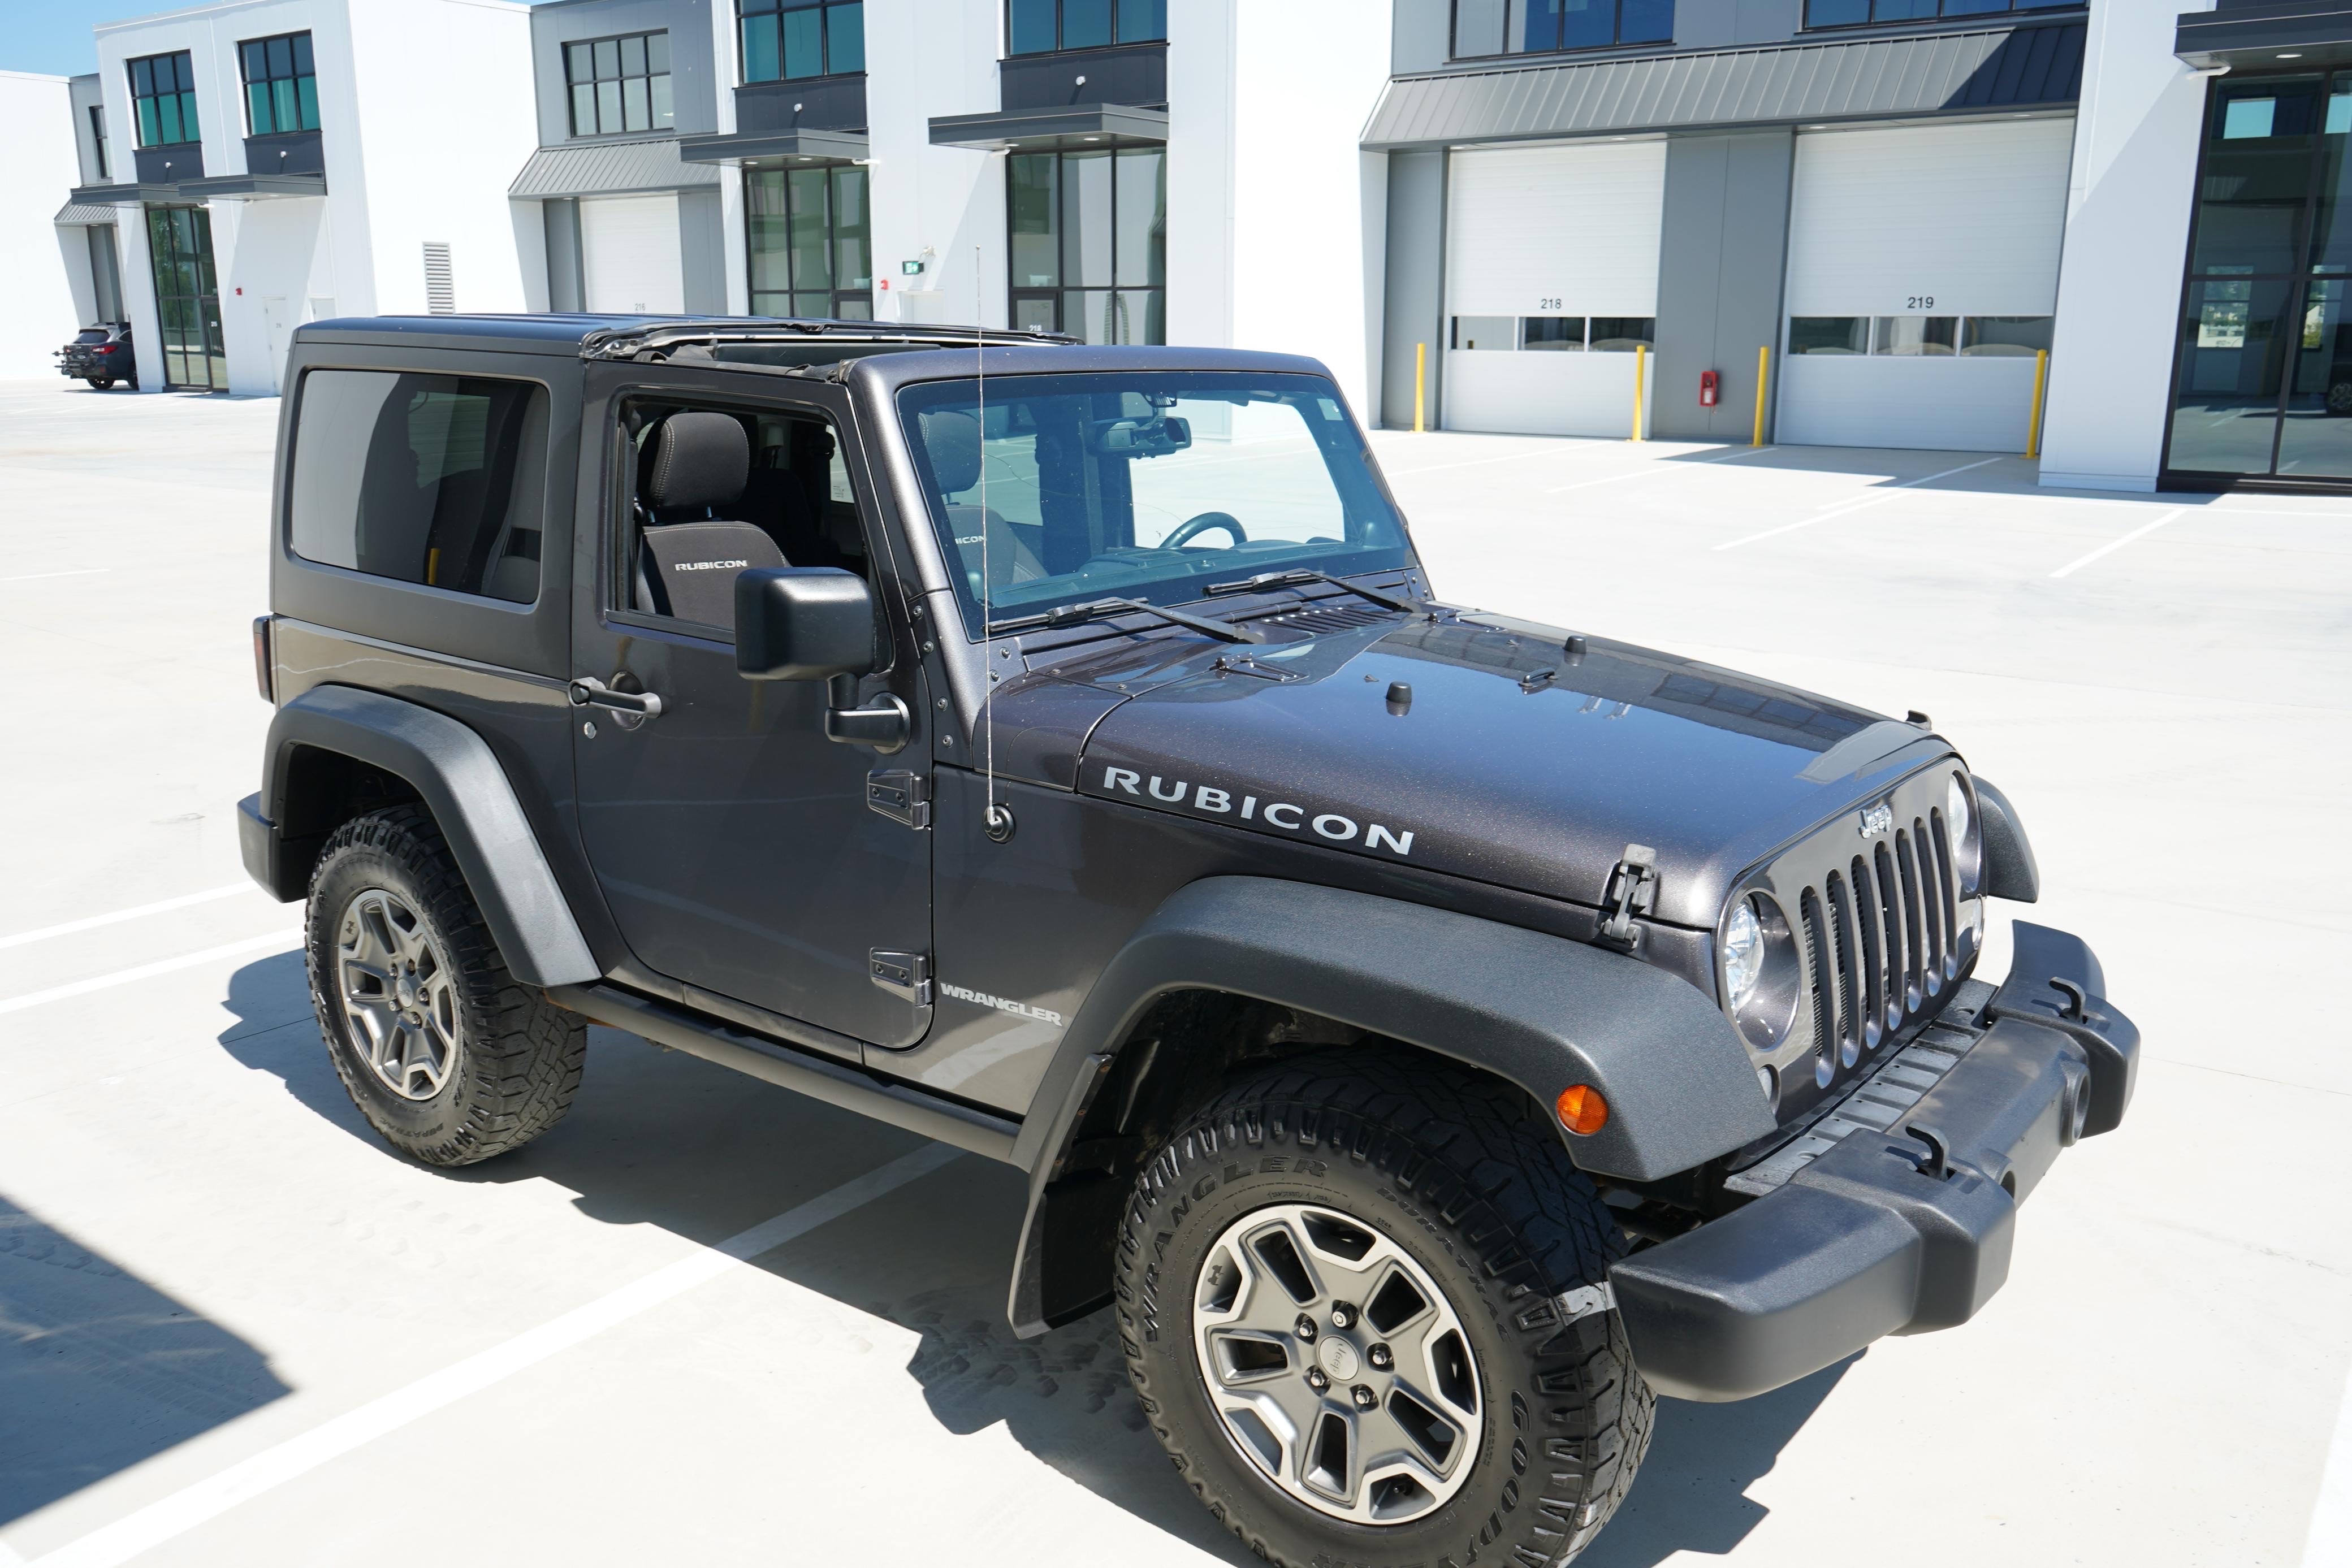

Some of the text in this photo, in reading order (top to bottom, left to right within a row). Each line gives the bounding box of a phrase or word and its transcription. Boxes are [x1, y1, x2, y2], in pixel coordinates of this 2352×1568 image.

[1541, 298, 1562, 309] 218
[1907, 297, 1934, 309] 219
[675, 560, 747, 571] RUBICON
[1104, 766, 1414, 855] RUBICON
[1858, 804, 1892, 839] Jeep
[940, 982, 1063, 1026] WRANGLER
[1144, 1155, 1328, 1342] WRANGLER
